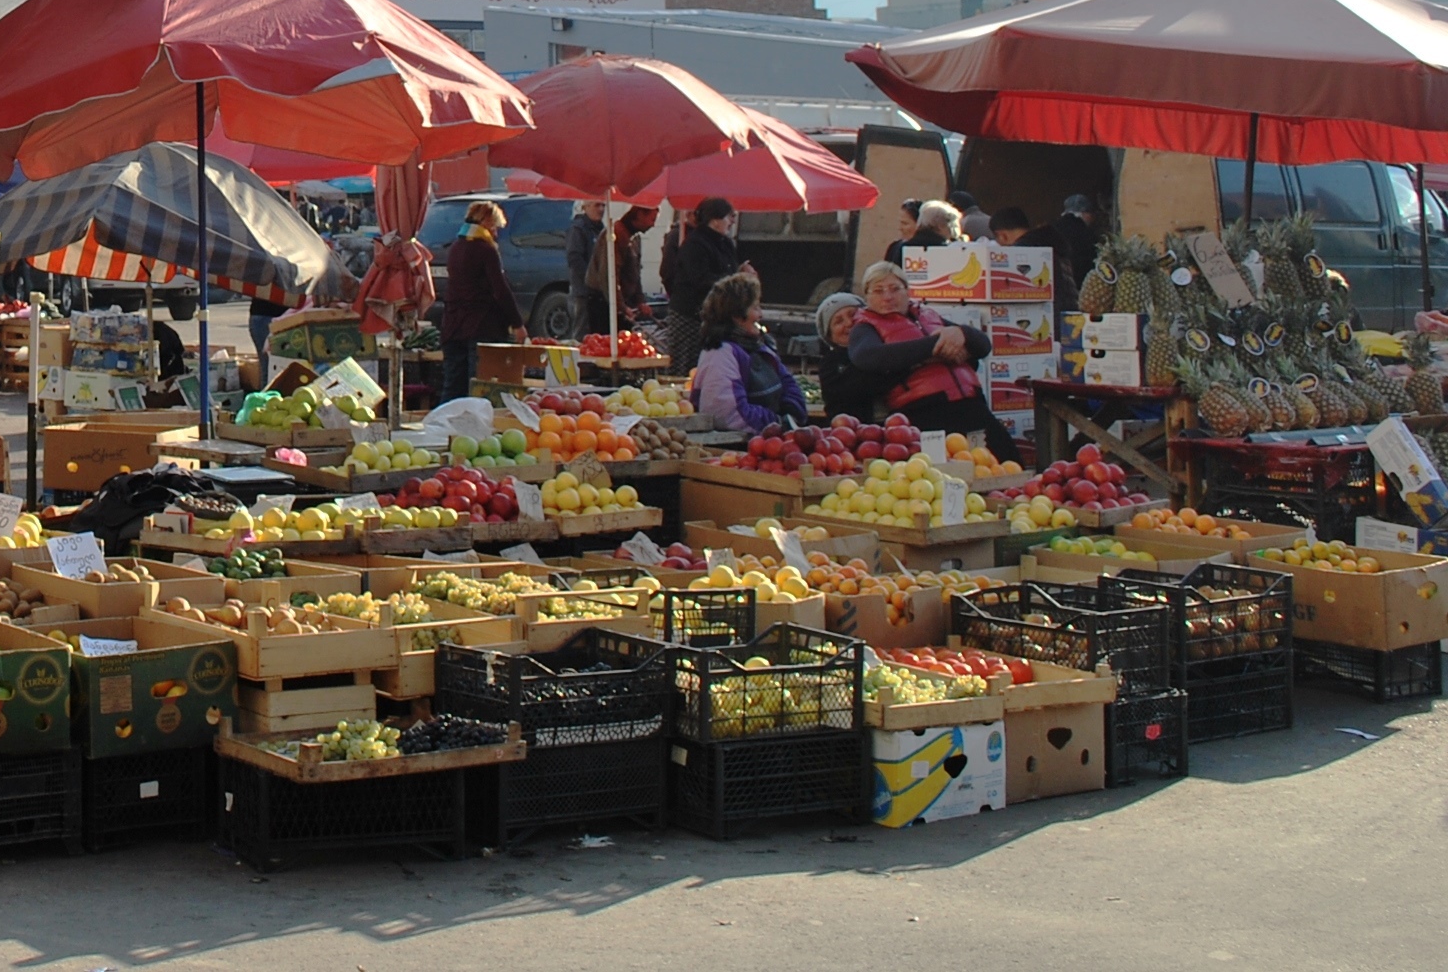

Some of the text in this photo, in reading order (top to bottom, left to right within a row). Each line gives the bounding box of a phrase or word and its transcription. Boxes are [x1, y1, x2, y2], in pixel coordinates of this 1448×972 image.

[990, 251, 1009, 263] Dole
[905, 257, 929, 270] Dole
[943, 288, 974, 298] BANANAS
[991, 305, 1009, 317] Dole
[990, 361, 1010, 373] Dole
